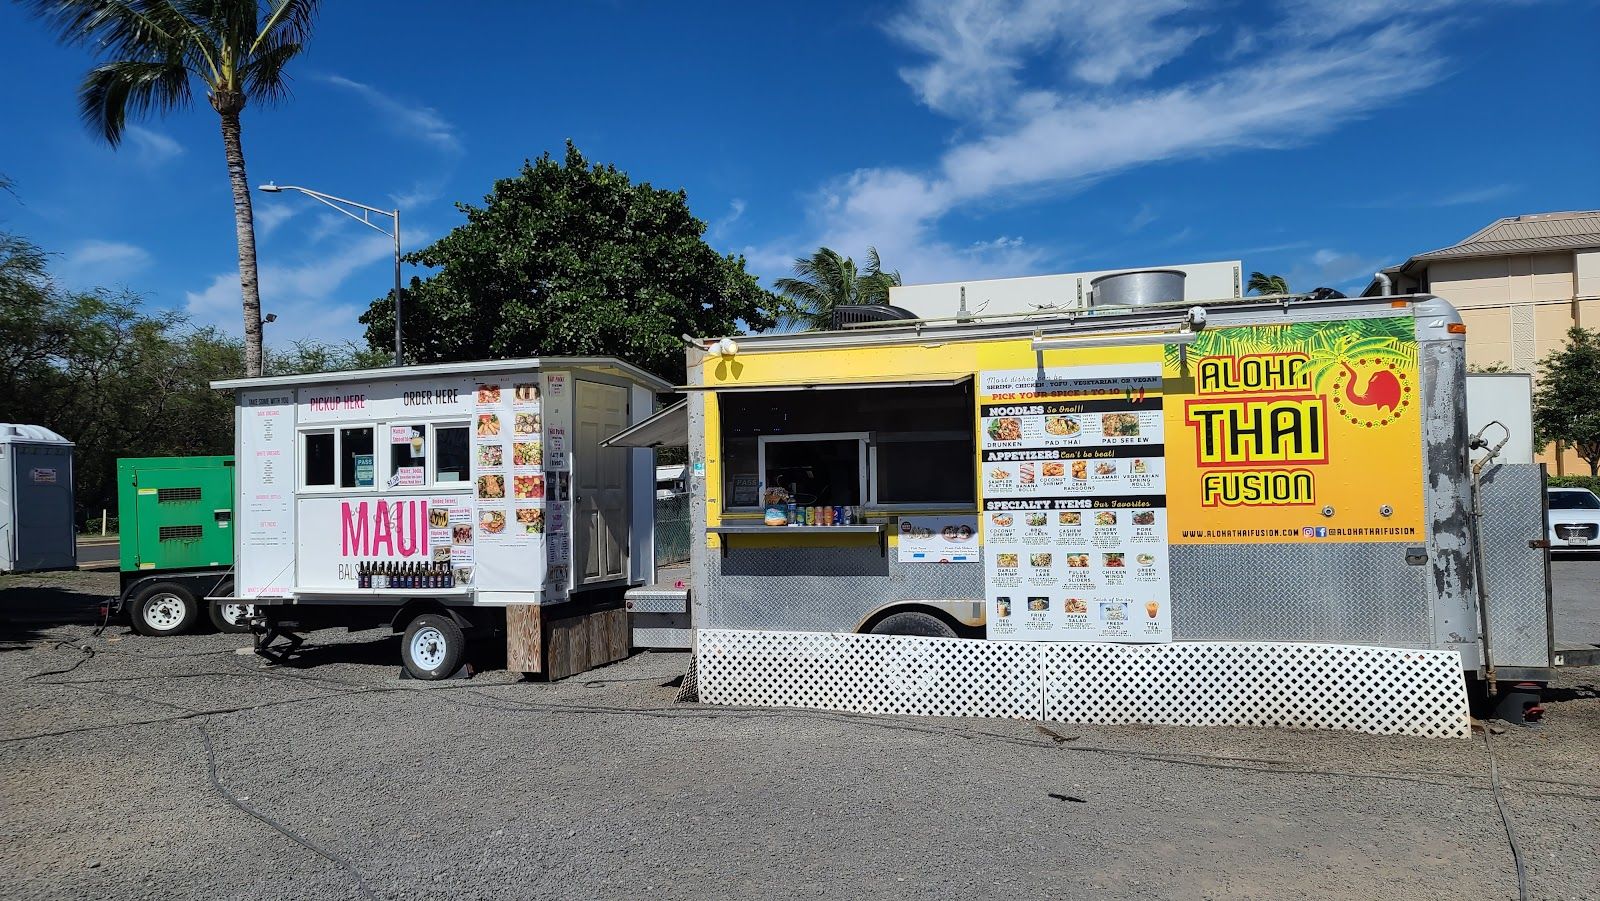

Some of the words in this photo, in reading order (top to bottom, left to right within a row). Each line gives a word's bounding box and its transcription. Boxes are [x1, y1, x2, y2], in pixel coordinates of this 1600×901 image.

[1010, 375, 1034, 383] dishes
[1201, 358, 1308, 389] ALOHA
[403, 390, 432, 406] ORDER
[435, 388, 459, 404] HERE
[992, 392, 1015, 400] PICK
[1019, 391, 1048, 399] YOUR
[1051, 389, 1080, 397] SPICE
[310, 396, 341, 412] PICKUP
[344, 394, 365, 410] HERE
[989, 405, 1045, 416] NOODLES
[1046, 405, 1057, 414] So
[1059, 404, 1083, 413] Ono!!!
[1194, 405, 1319, 457] THAI
[987, 450, 1060, 461] APPETIZERS
[1060, 450, 1081, 459] Can't
[1082, 450, 1092, 458] be
[1094, 450, 1115, 458] beat!
[1204, 473, 1312, 502] FUSION
[986, 499, 1051, 510] SPECIALTY
[1054, 499, 1092, 509] ITEMS
[1093, 500, 1109, 508] Our
[1111, 499, 1151, 508] Favorites
[341, 498, 428, 558] MAUI
[1182, 528, 1299, 538] WWW.ALOHATHAIFUSION.COM
[1328, 527, 1415, 537] @ALOHATHAIFUSION
